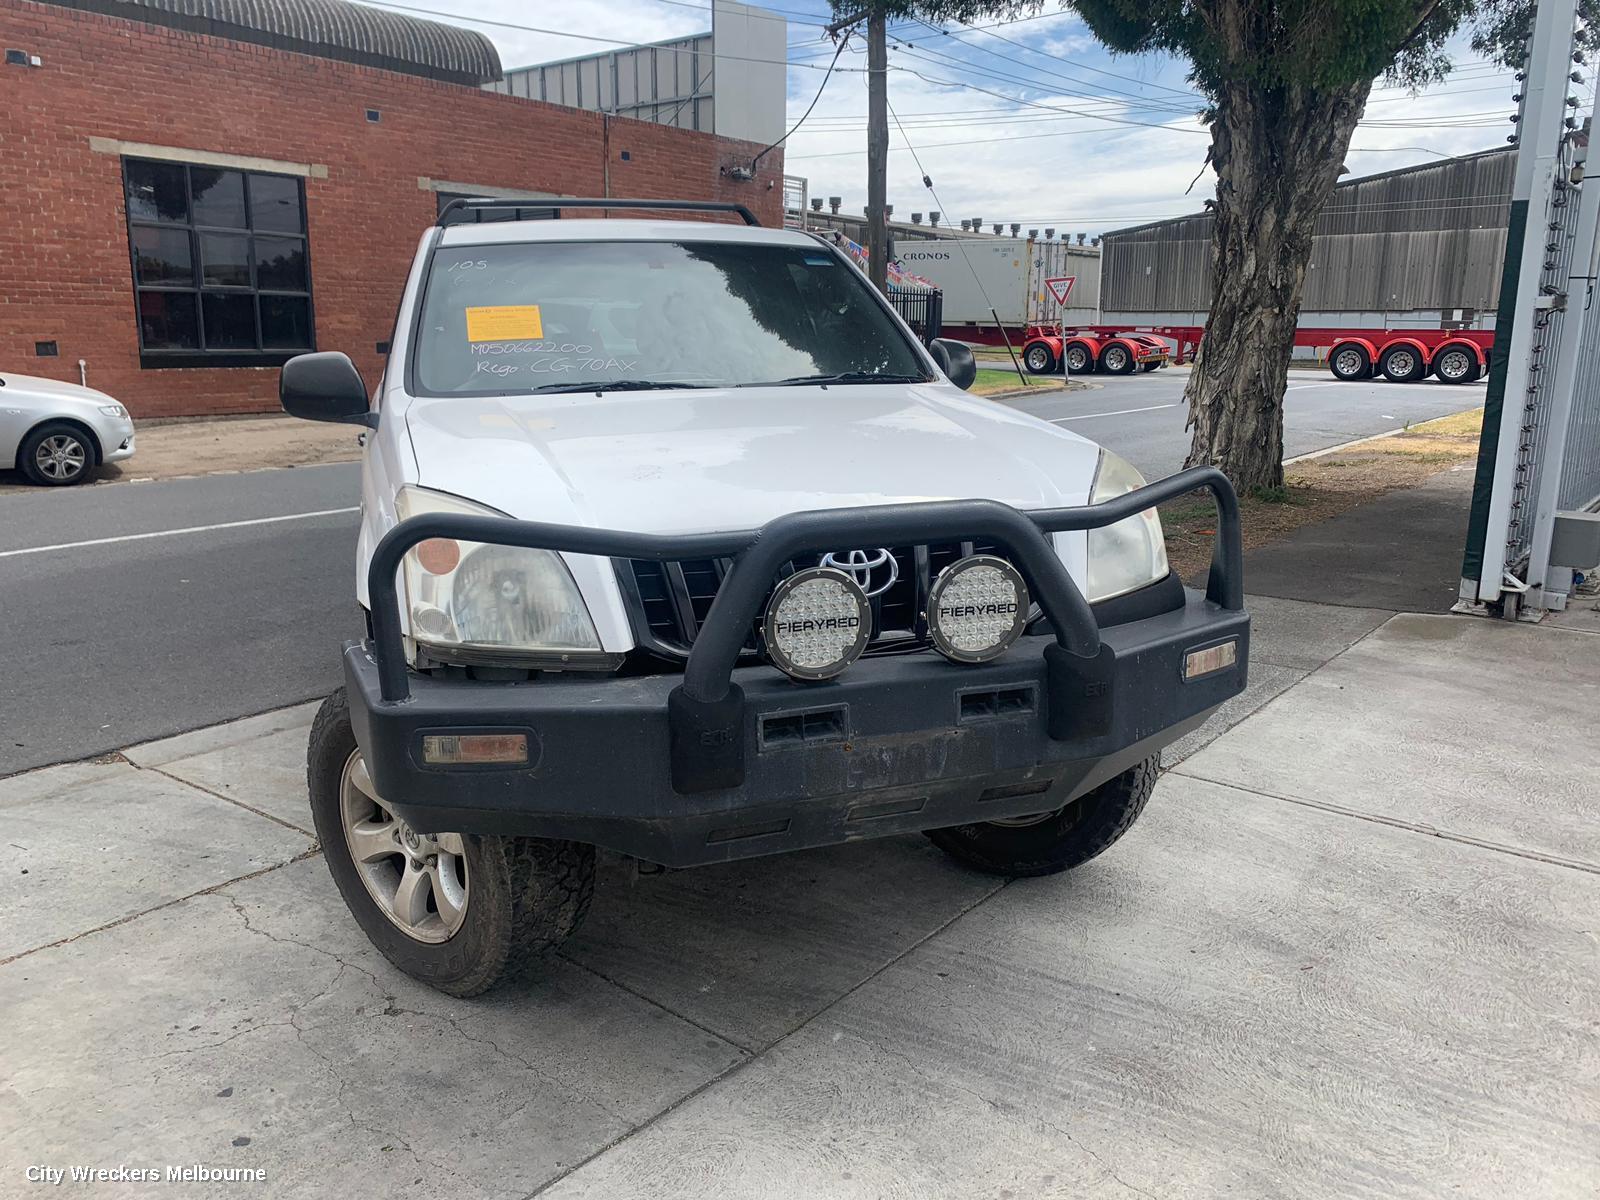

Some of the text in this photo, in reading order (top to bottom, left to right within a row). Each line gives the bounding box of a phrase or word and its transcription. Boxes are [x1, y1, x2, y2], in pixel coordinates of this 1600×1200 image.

[903, 252, 950, 261] CRONOS
[447, 260, 488, 272] 105
[477, 361, 519, 377] Rego
[940, 603, 1018, 618] FIERYRED
[777, 616, 860, 634] FIERYRED
